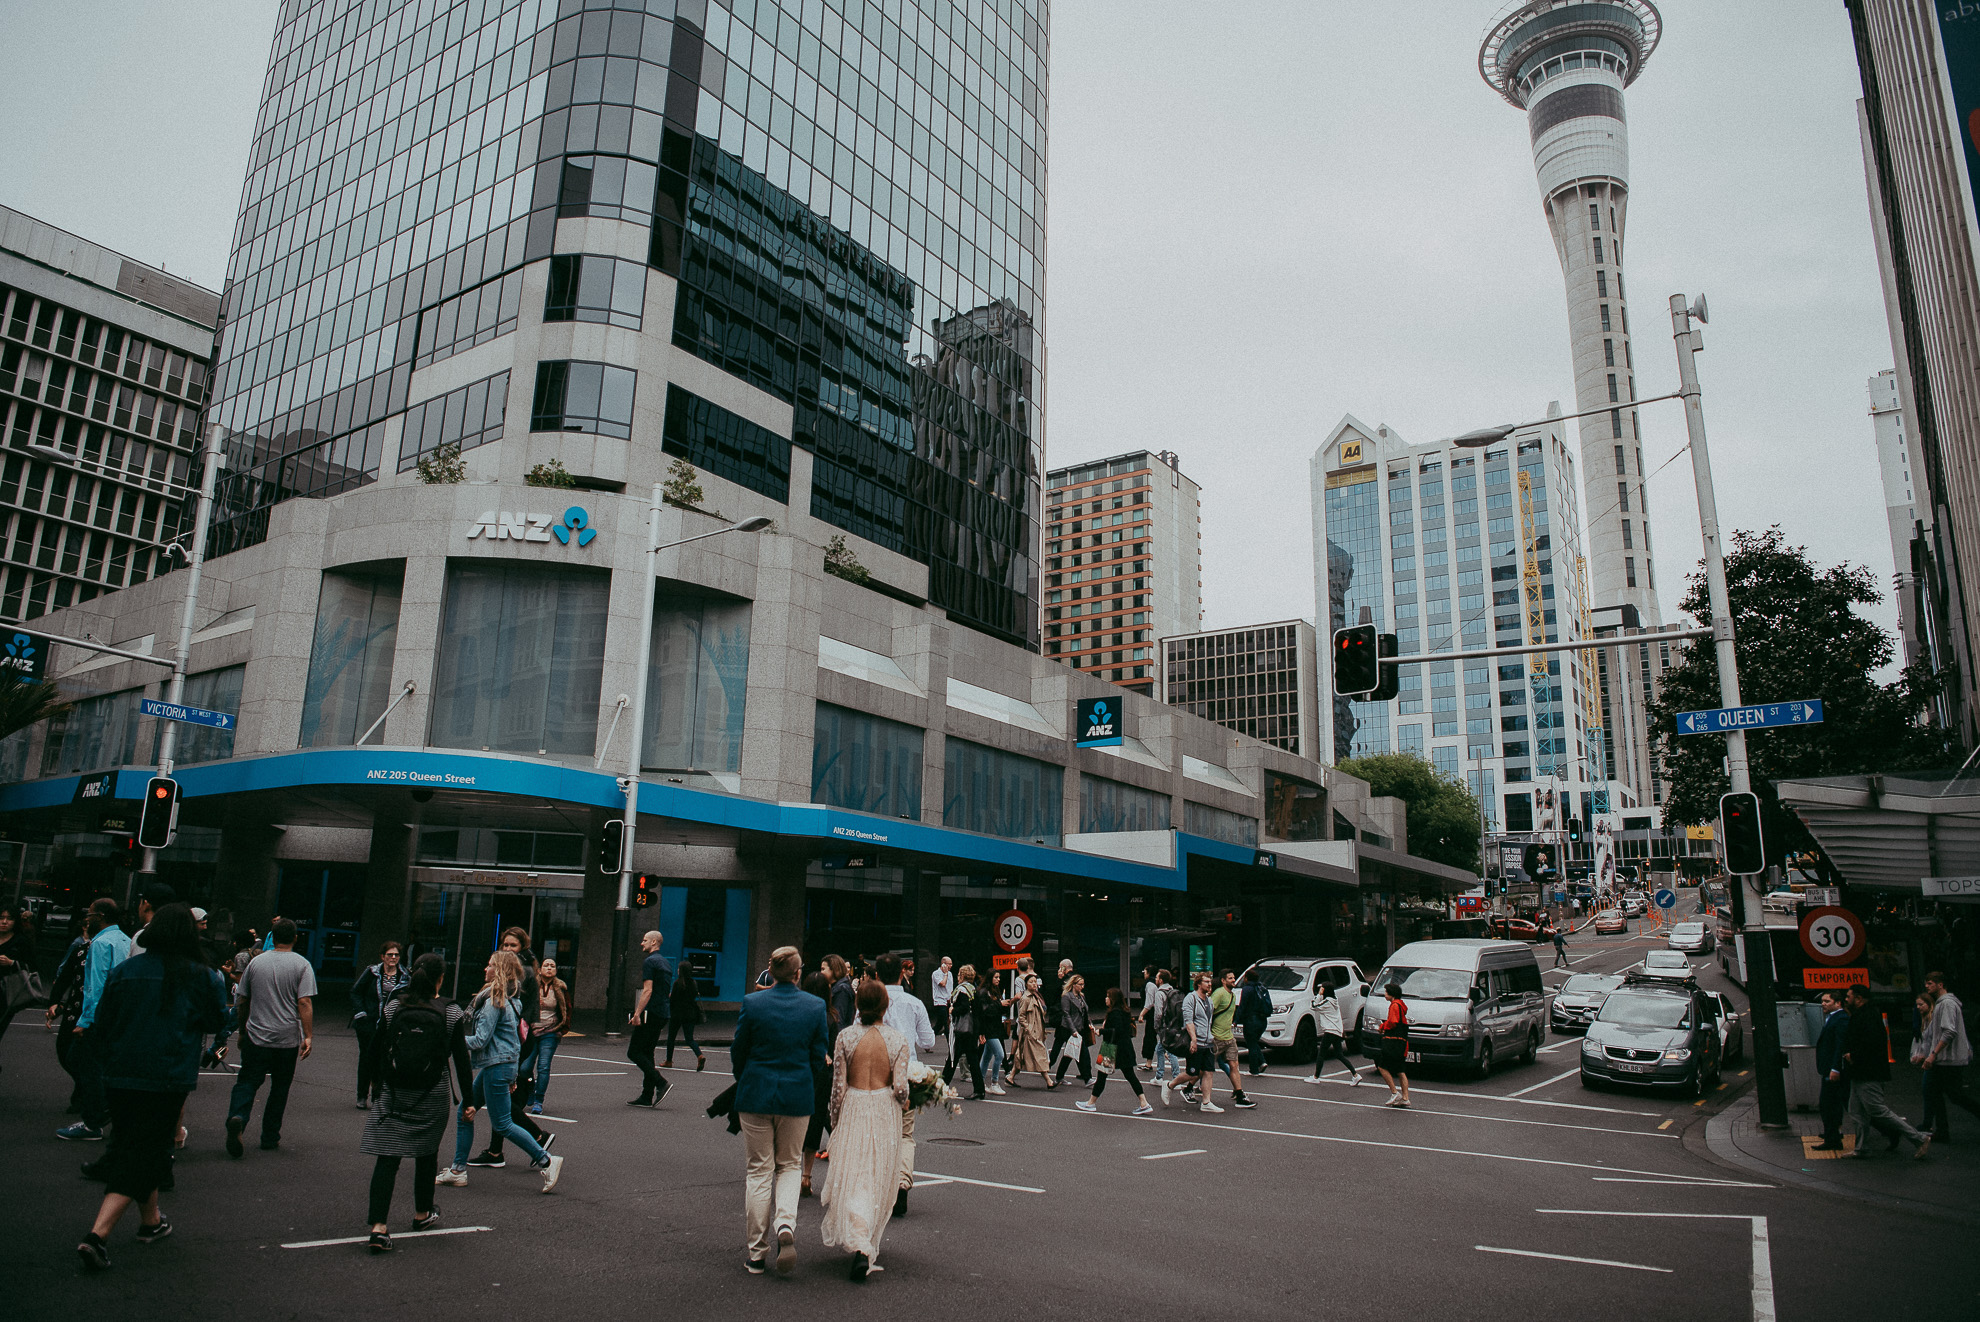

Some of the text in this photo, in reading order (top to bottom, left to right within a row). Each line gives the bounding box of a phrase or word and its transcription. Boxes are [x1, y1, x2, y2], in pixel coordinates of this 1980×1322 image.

[1945, 0, 1980, 21] ab
[1343, 445, 1361, 459] AA
[466, 511, 553, 542] ANZ
[147, 702, 187, 719] VICTORIA
[199, 710, 211, 718] WEST
[1790, 703, 1802, 711] 203
[1695, 712, 1708, 720] 205
[1718, 706, 1780, 727] QUEEN ST
[1086, 724, 1113, 737] ANZ
[1696, 723, 1709, 731] 265
[367, 769, 476, 785] ANZ 205 Queen Street
[82, 781, 102, 798] ANZ
[104, 819, 126, 829] ANZ
[833, 826, 888, 842] ANZ 205 Queen Street
[848, 858, 864, 867] ANZ
[1504, 854, 1522, 862] ASSION
[1504, 861, 1522, 869] URPOSE
[475, 873, 508, 886] Queen
[516, 874, 549, 887] Street
[1937, 879, 1980, 893] TOPS
[636, 893, 647, 906] 23
[1003, 923, 1024, 939] 30
[1816, 926, 1851, 948] 30
[996, 957, 1020, 967] TEMPOR
[1808, 973, 1864, 985] TEMPORARY
